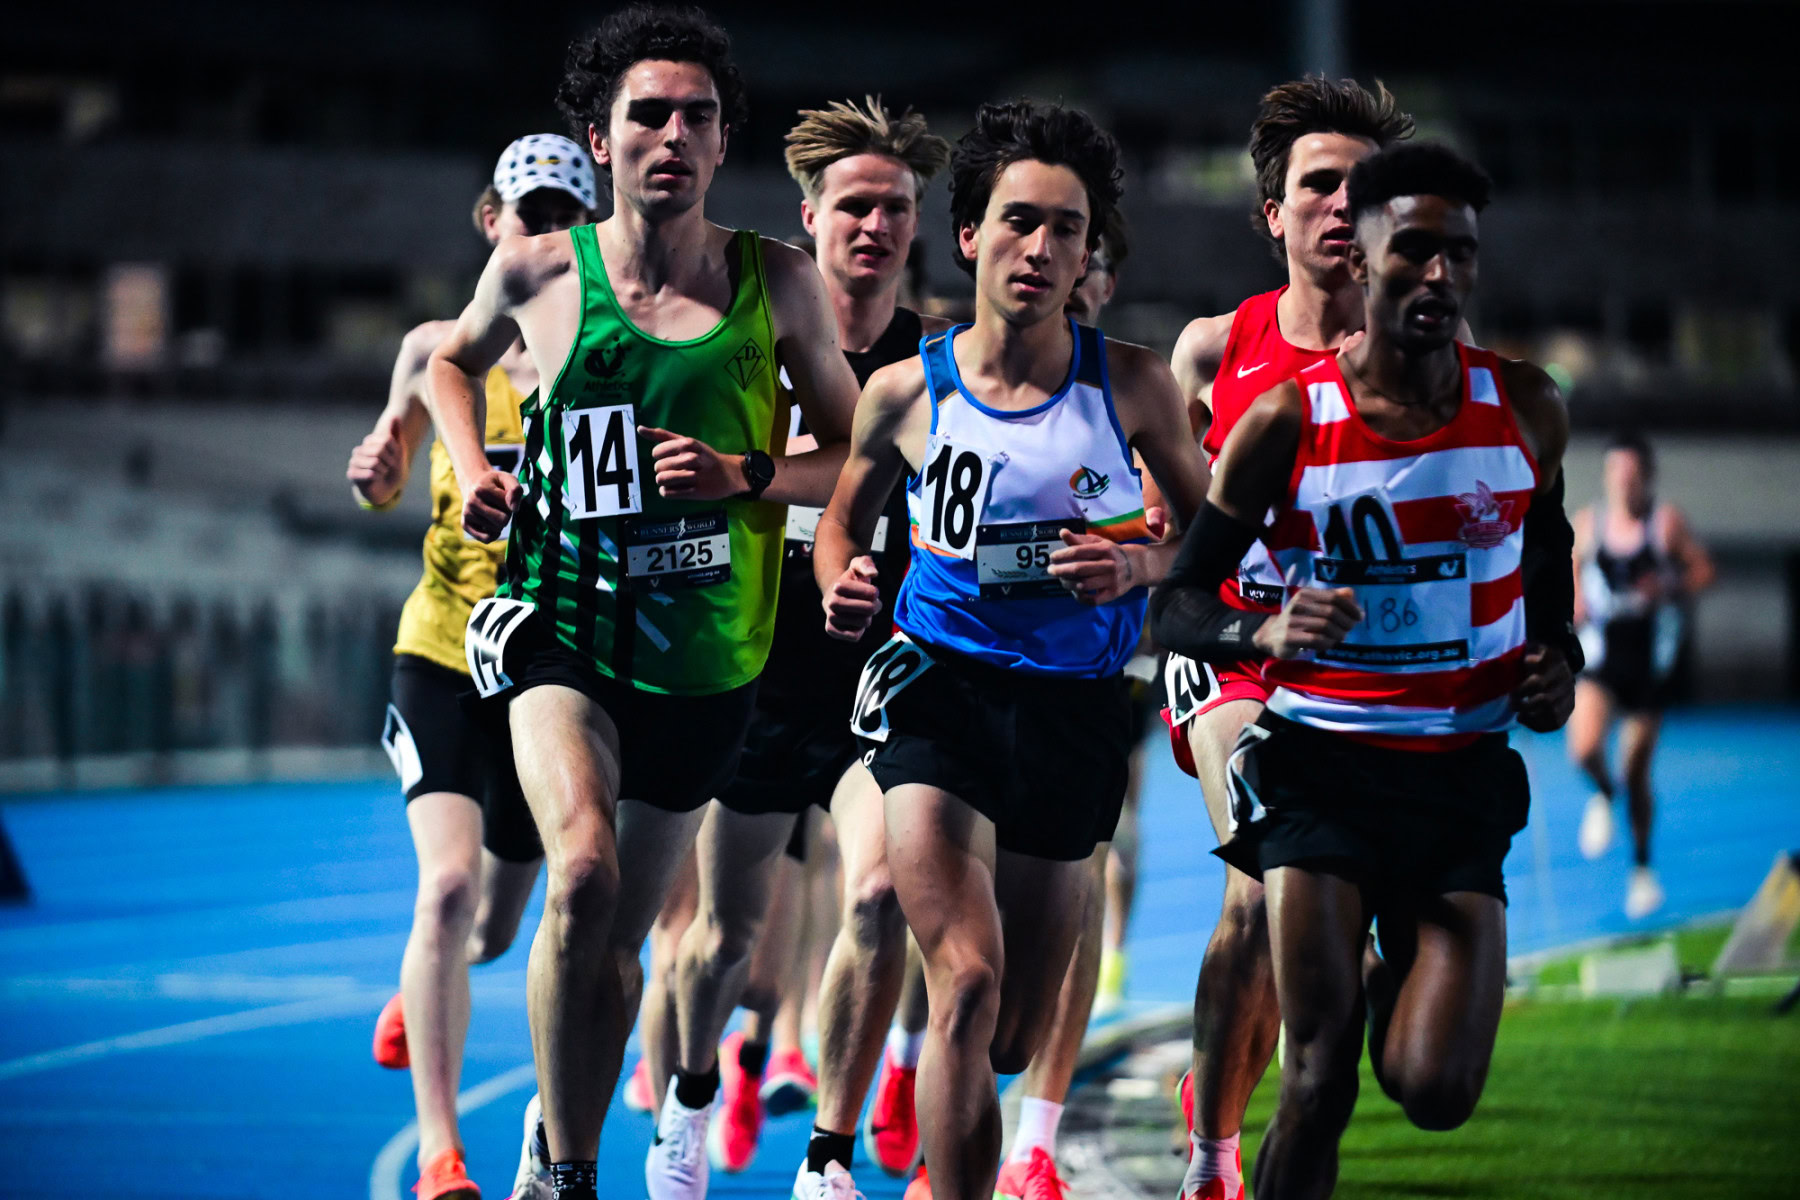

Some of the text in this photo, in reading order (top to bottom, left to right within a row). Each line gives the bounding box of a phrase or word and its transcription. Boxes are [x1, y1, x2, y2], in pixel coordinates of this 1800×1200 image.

[569, 411, 633, 513] 14
[687, 520, 716, 530] WORLD
[926, 445, 983, 550] 18
[647, 540, 713, 572] 2125
[1016, 544, 1050, 570] 95
[470, 601, 525, 691] 14
